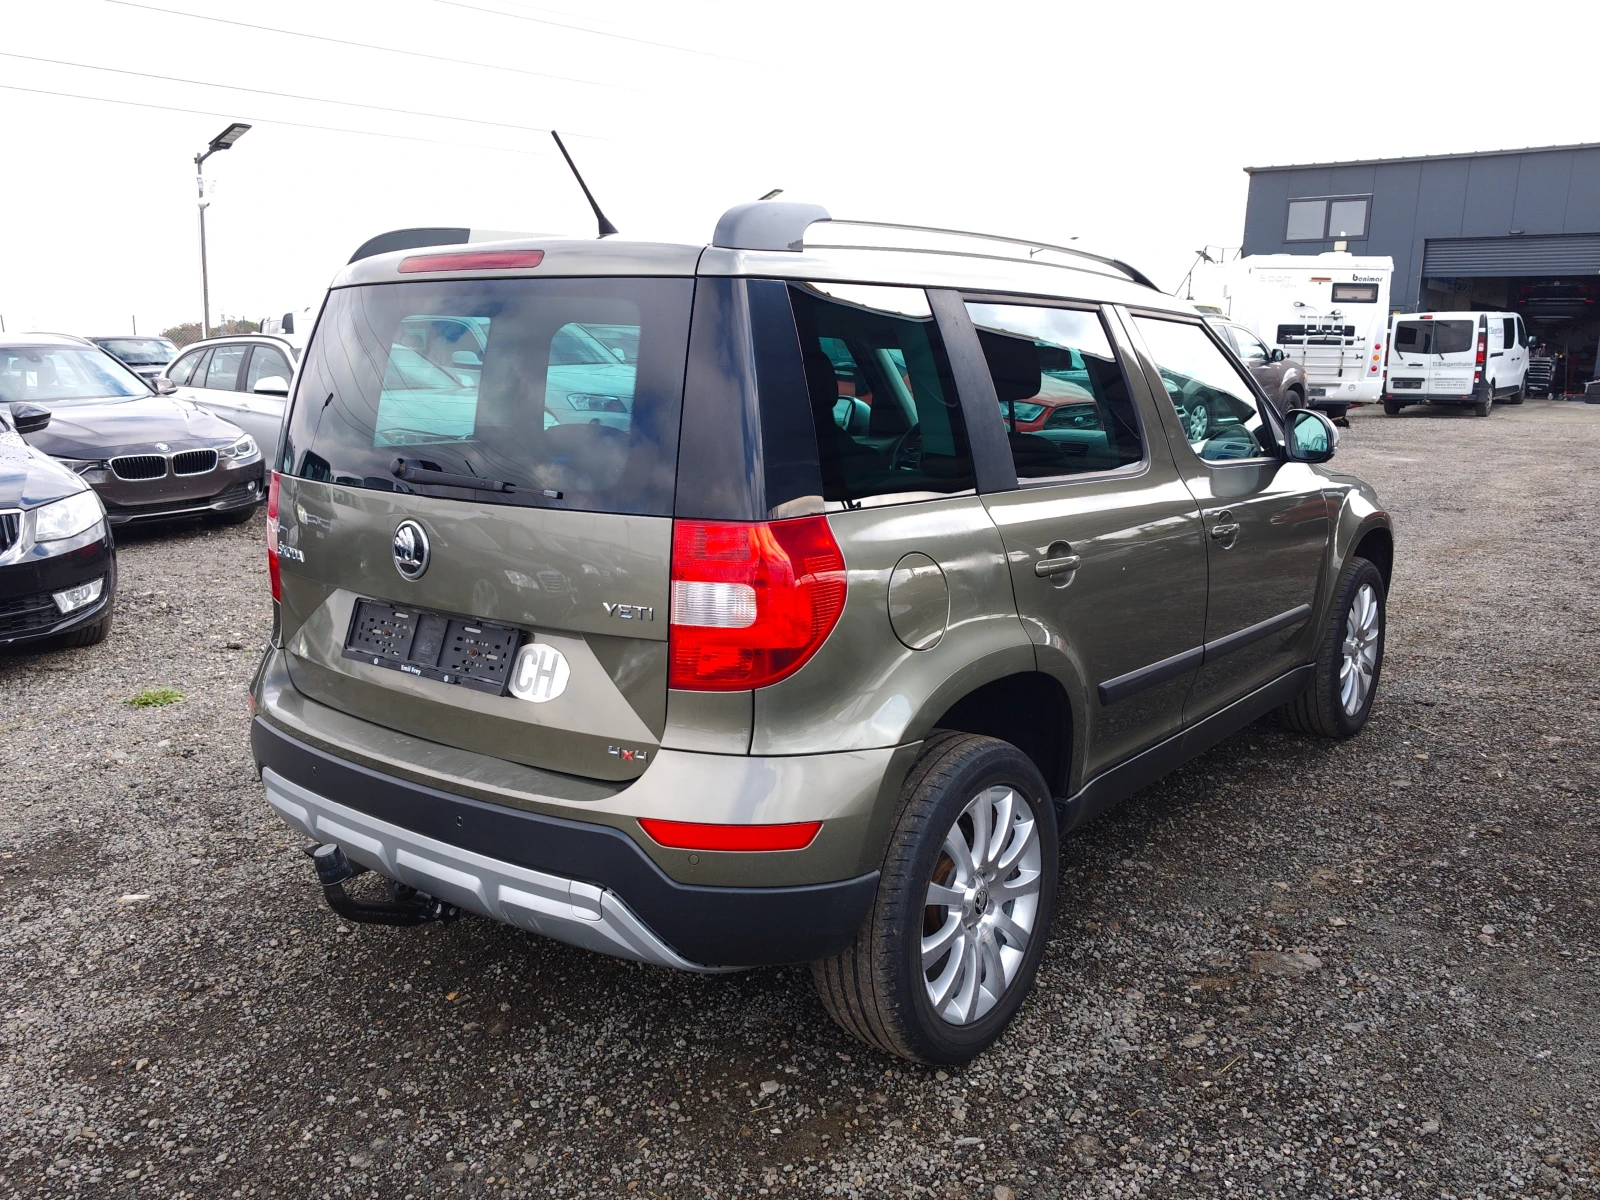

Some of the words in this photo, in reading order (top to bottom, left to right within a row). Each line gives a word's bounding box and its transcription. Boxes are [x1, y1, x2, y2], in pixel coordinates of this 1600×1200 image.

[1352, 273, 1383, 283] benimar
[602, 601, 655, 622] YETI
[400, 664, 411, 673] Emil
[514, 647, 560, 700] CH
